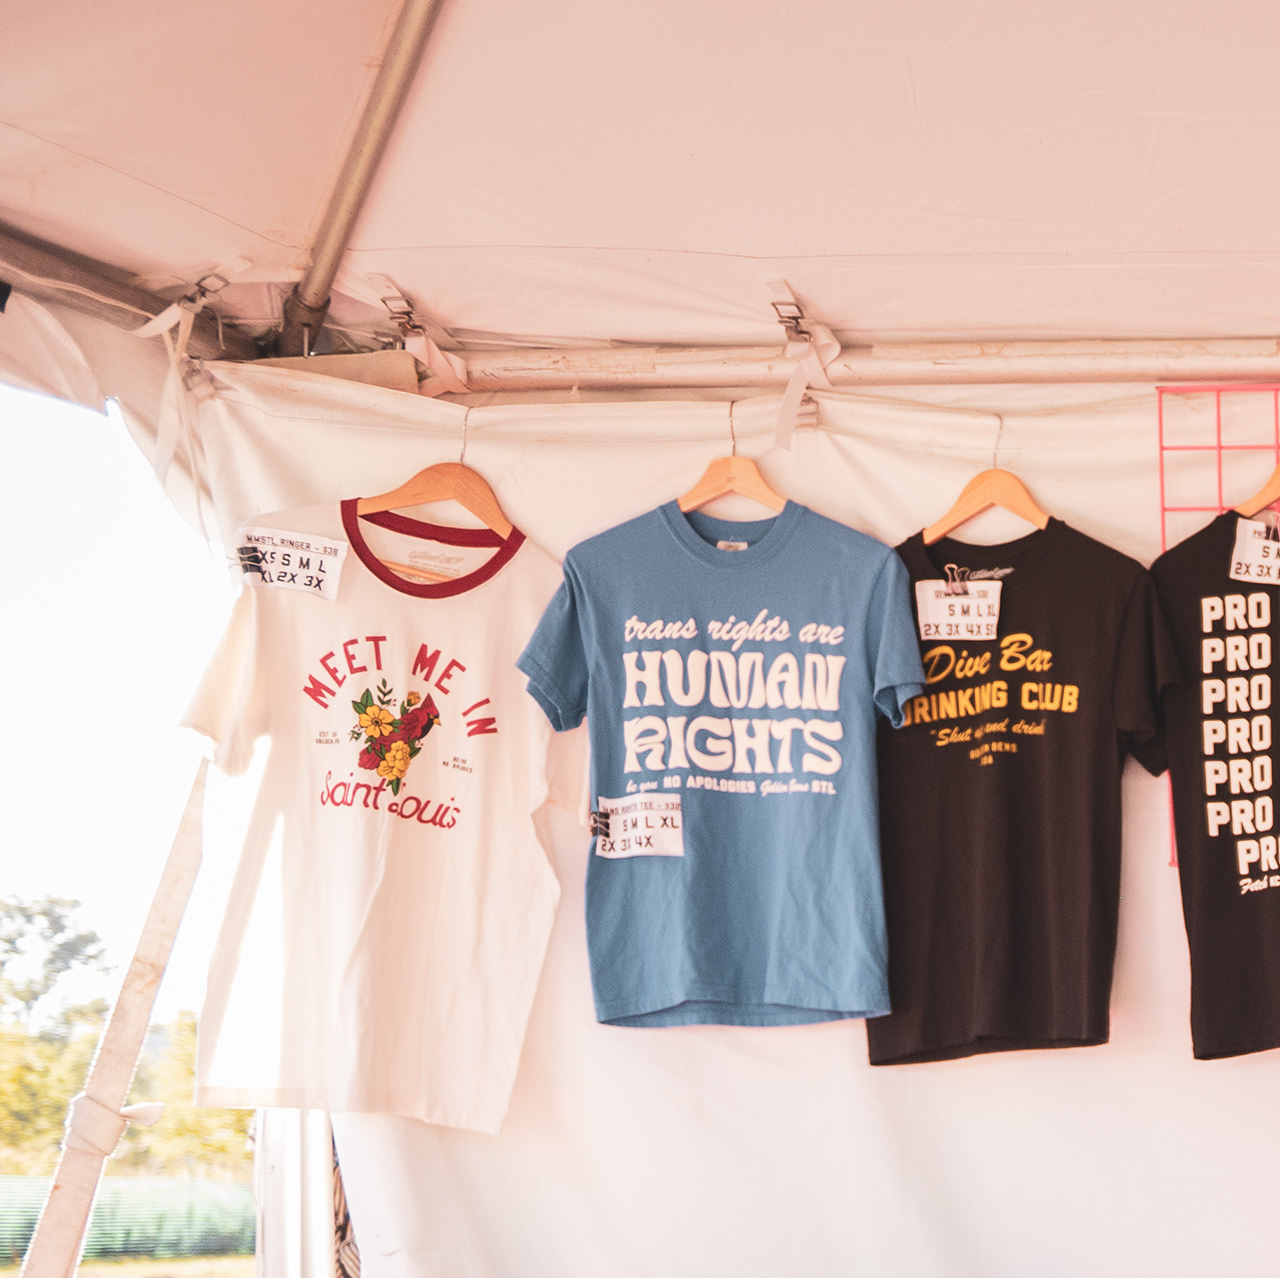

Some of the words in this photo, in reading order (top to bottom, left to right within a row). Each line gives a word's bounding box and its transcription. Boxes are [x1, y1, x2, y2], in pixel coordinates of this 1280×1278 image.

[277, 571, 298, 584] 2X
[304, 575, 324, 591] 3X
[1235, 562, 1251, 576] 2X
[1256, 564, 1272, 578] 3X
[624, 615, 699, 642] trans
[708, 609, 791, 650] rights
[799, 621, 845, 644] are
[924, 624, 941, 636] 2X
[946, 624, 960, 636] 3X
[966, 624, 982, 636] 4X
[1201, 592, 1271, 633] PRO
[923, 645, 992, 685] Dive
[1000, 632, 1053, 673] Bar
[1201, 633, 1272, 675] PRO
[303, 635, 388, 710] MEET
[411, 642, 467, 695] ME
[462, 697, 498, 738] IN
[622, 650, 847, 712] HUMAN
[1201, 675, 1271, 715] PRO
[622, 714, 844, 775] RIGHTS
[1201, 715, 1273, 756] PRO
[320, 770, 388, 811] Saint
[663, 776, 682, 788] NO
[686, 776, 756, 793] APOLOGIES
[811, 780, 837, 795] STL
[1203, 755, 1273, 796] PRO
[622, 819, 628, 832] S
[631, 818, 638, 829] M
[645, 816, 654, 828] L
[660, 815, 680, 829] XL
[639, 802, 654, 811] TEE
[1205, 795, 1274, 838] PRO
[601, 839, 616, 852] 2X
[621, 838, 631, 851] 3X
[634, 835, 654, 848] 4X
